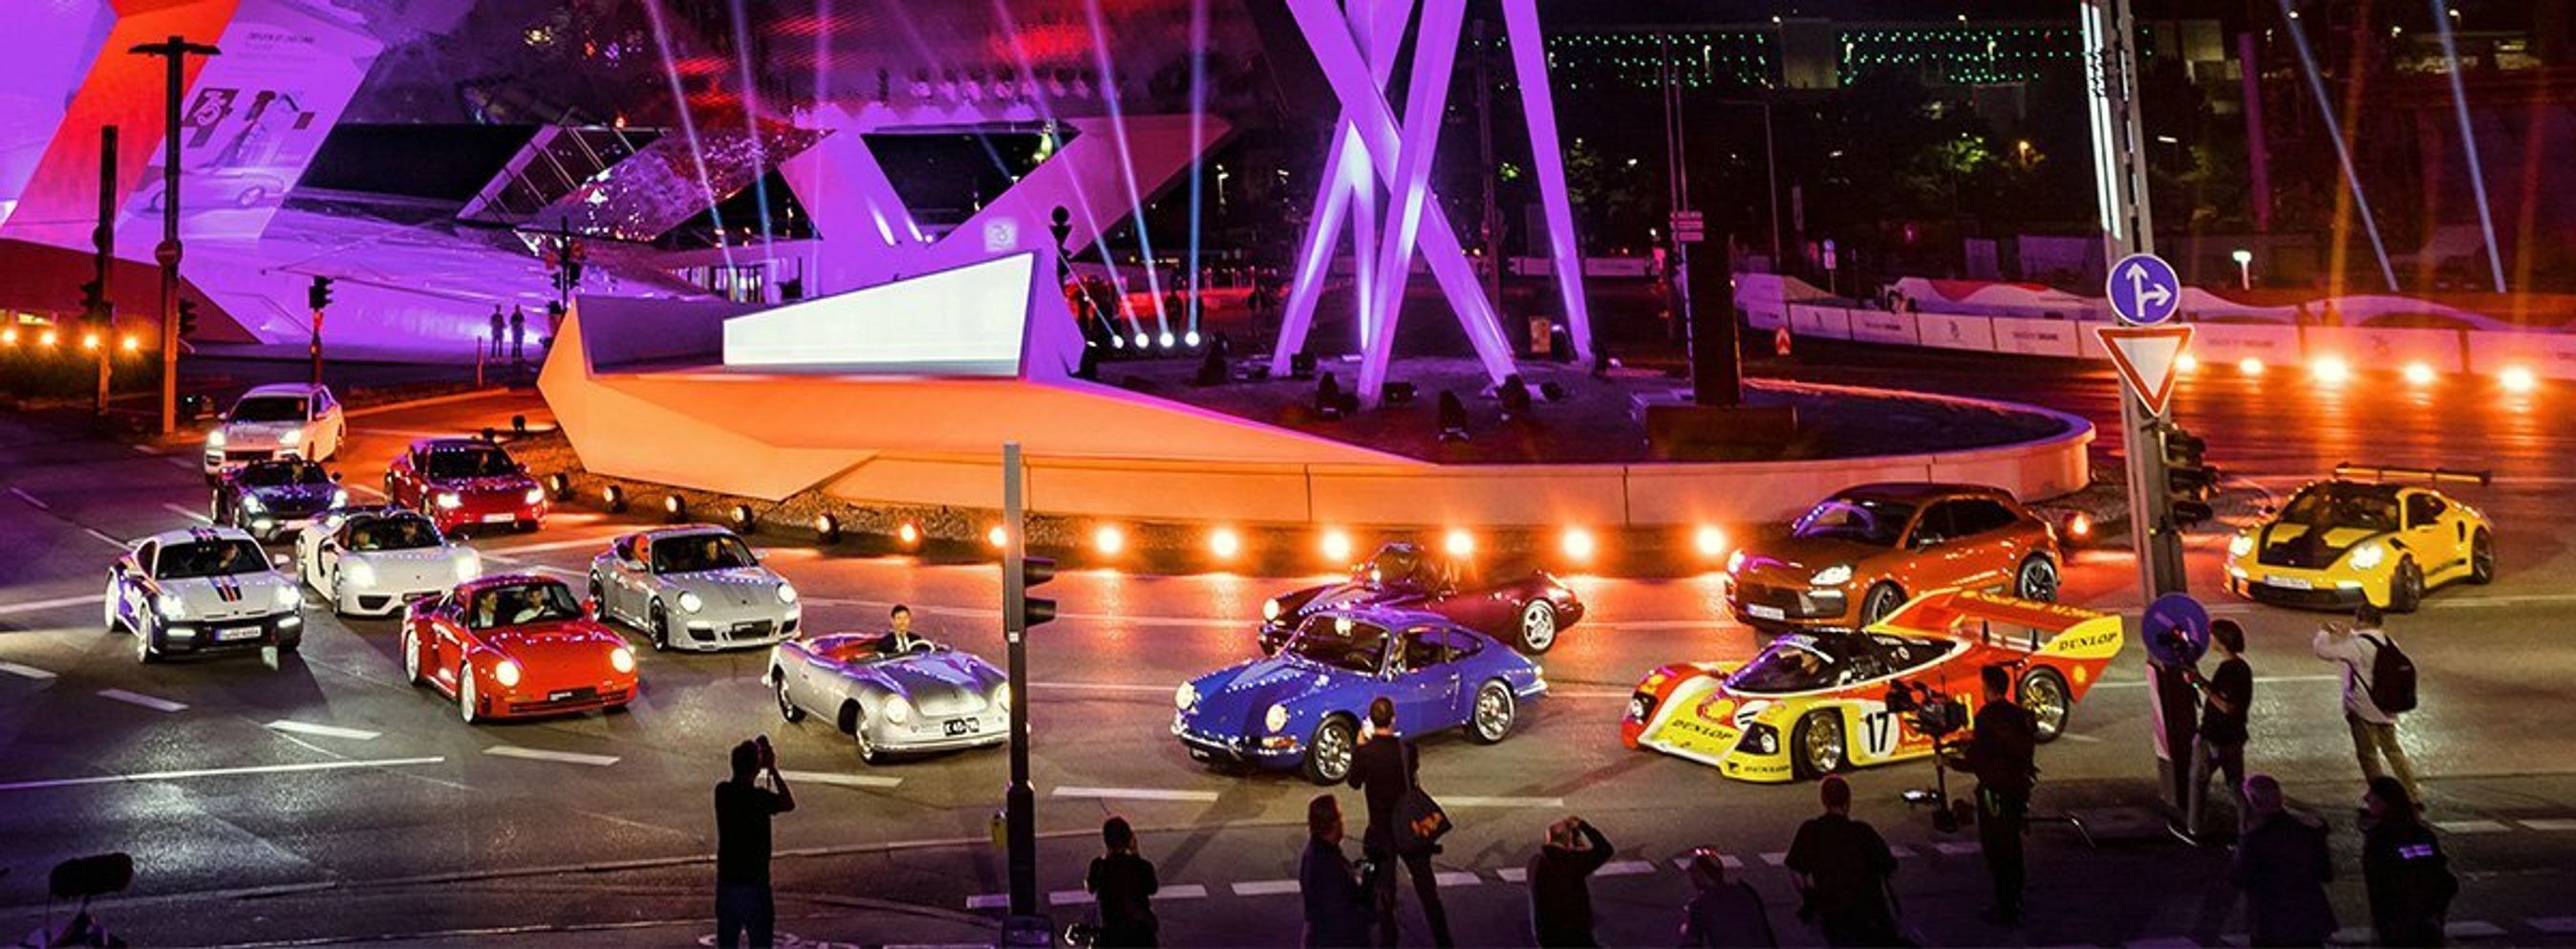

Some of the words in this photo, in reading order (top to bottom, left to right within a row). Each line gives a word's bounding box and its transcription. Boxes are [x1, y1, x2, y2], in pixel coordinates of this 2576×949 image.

[2059, 633, 2117, 651] DUNLOP
[1672, 719, 1733, 740] DUNLOP
[1866, 712, 1889, 753] 17
